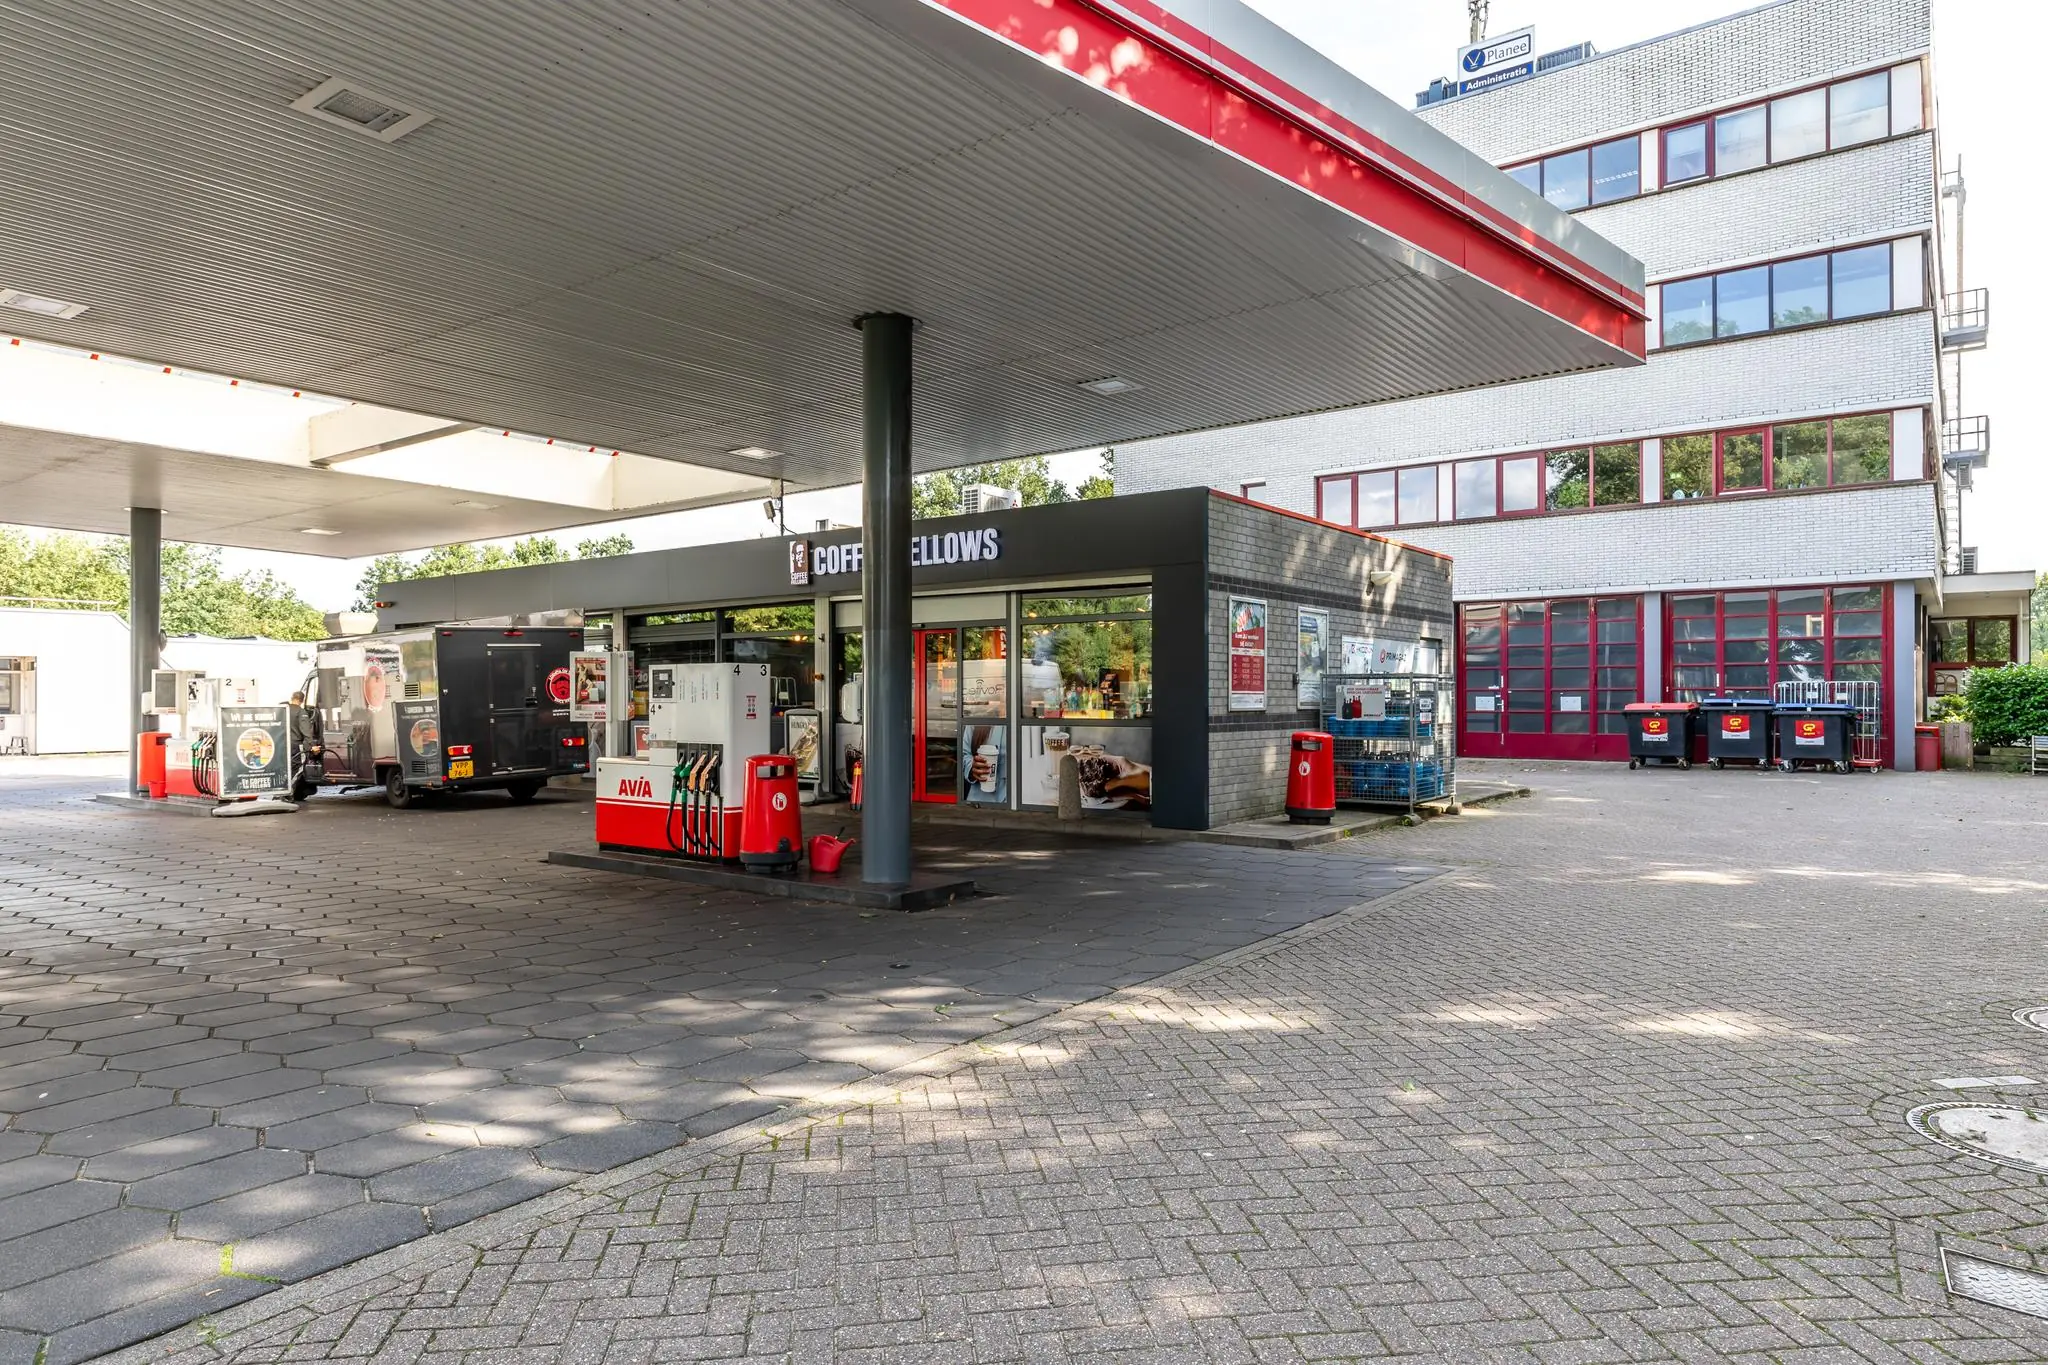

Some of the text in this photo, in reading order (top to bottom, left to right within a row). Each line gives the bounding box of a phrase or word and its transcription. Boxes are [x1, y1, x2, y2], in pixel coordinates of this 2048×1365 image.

[1487, 42, 1527, 62] Planee
[1466, 67, 1527, 91] Administratie
[814, 528, 998, 576] COFF ELLOWS
[734, 664, 767, 676] 4 3
[225, 678, 255, 686] 2 1
[650, 704, 656, 715] 4
